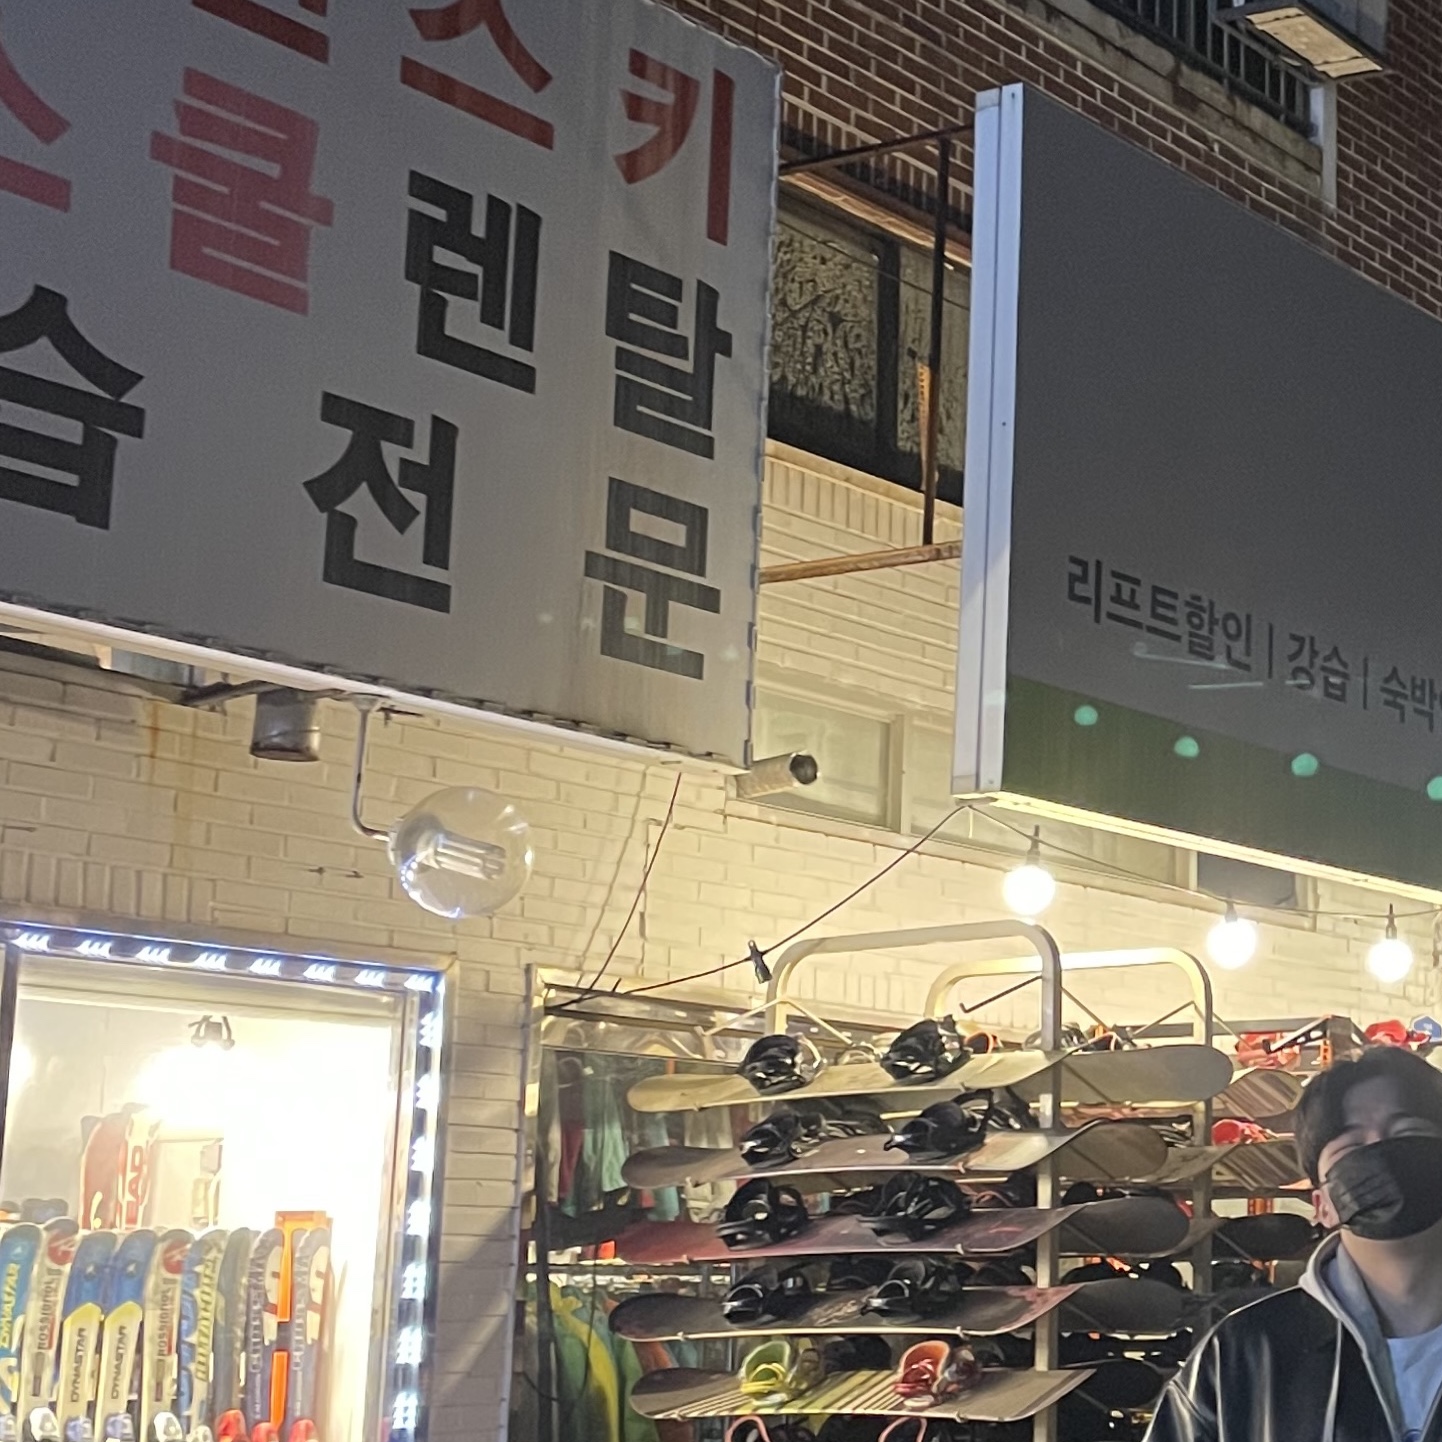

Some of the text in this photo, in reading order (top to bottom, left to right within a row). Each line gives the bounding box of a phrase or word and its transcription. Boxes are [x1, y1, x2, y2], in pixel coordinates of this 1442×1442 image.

[403, 168, 733, 461] 렌탈
[1067, 555, 1252, 672] 리프트할인
[1287, 631, 1351, 703] 강습
[70, 1327, 87, 1403] DYNASTAR
[110, 1324, 128, 1400] DYNASTAR
